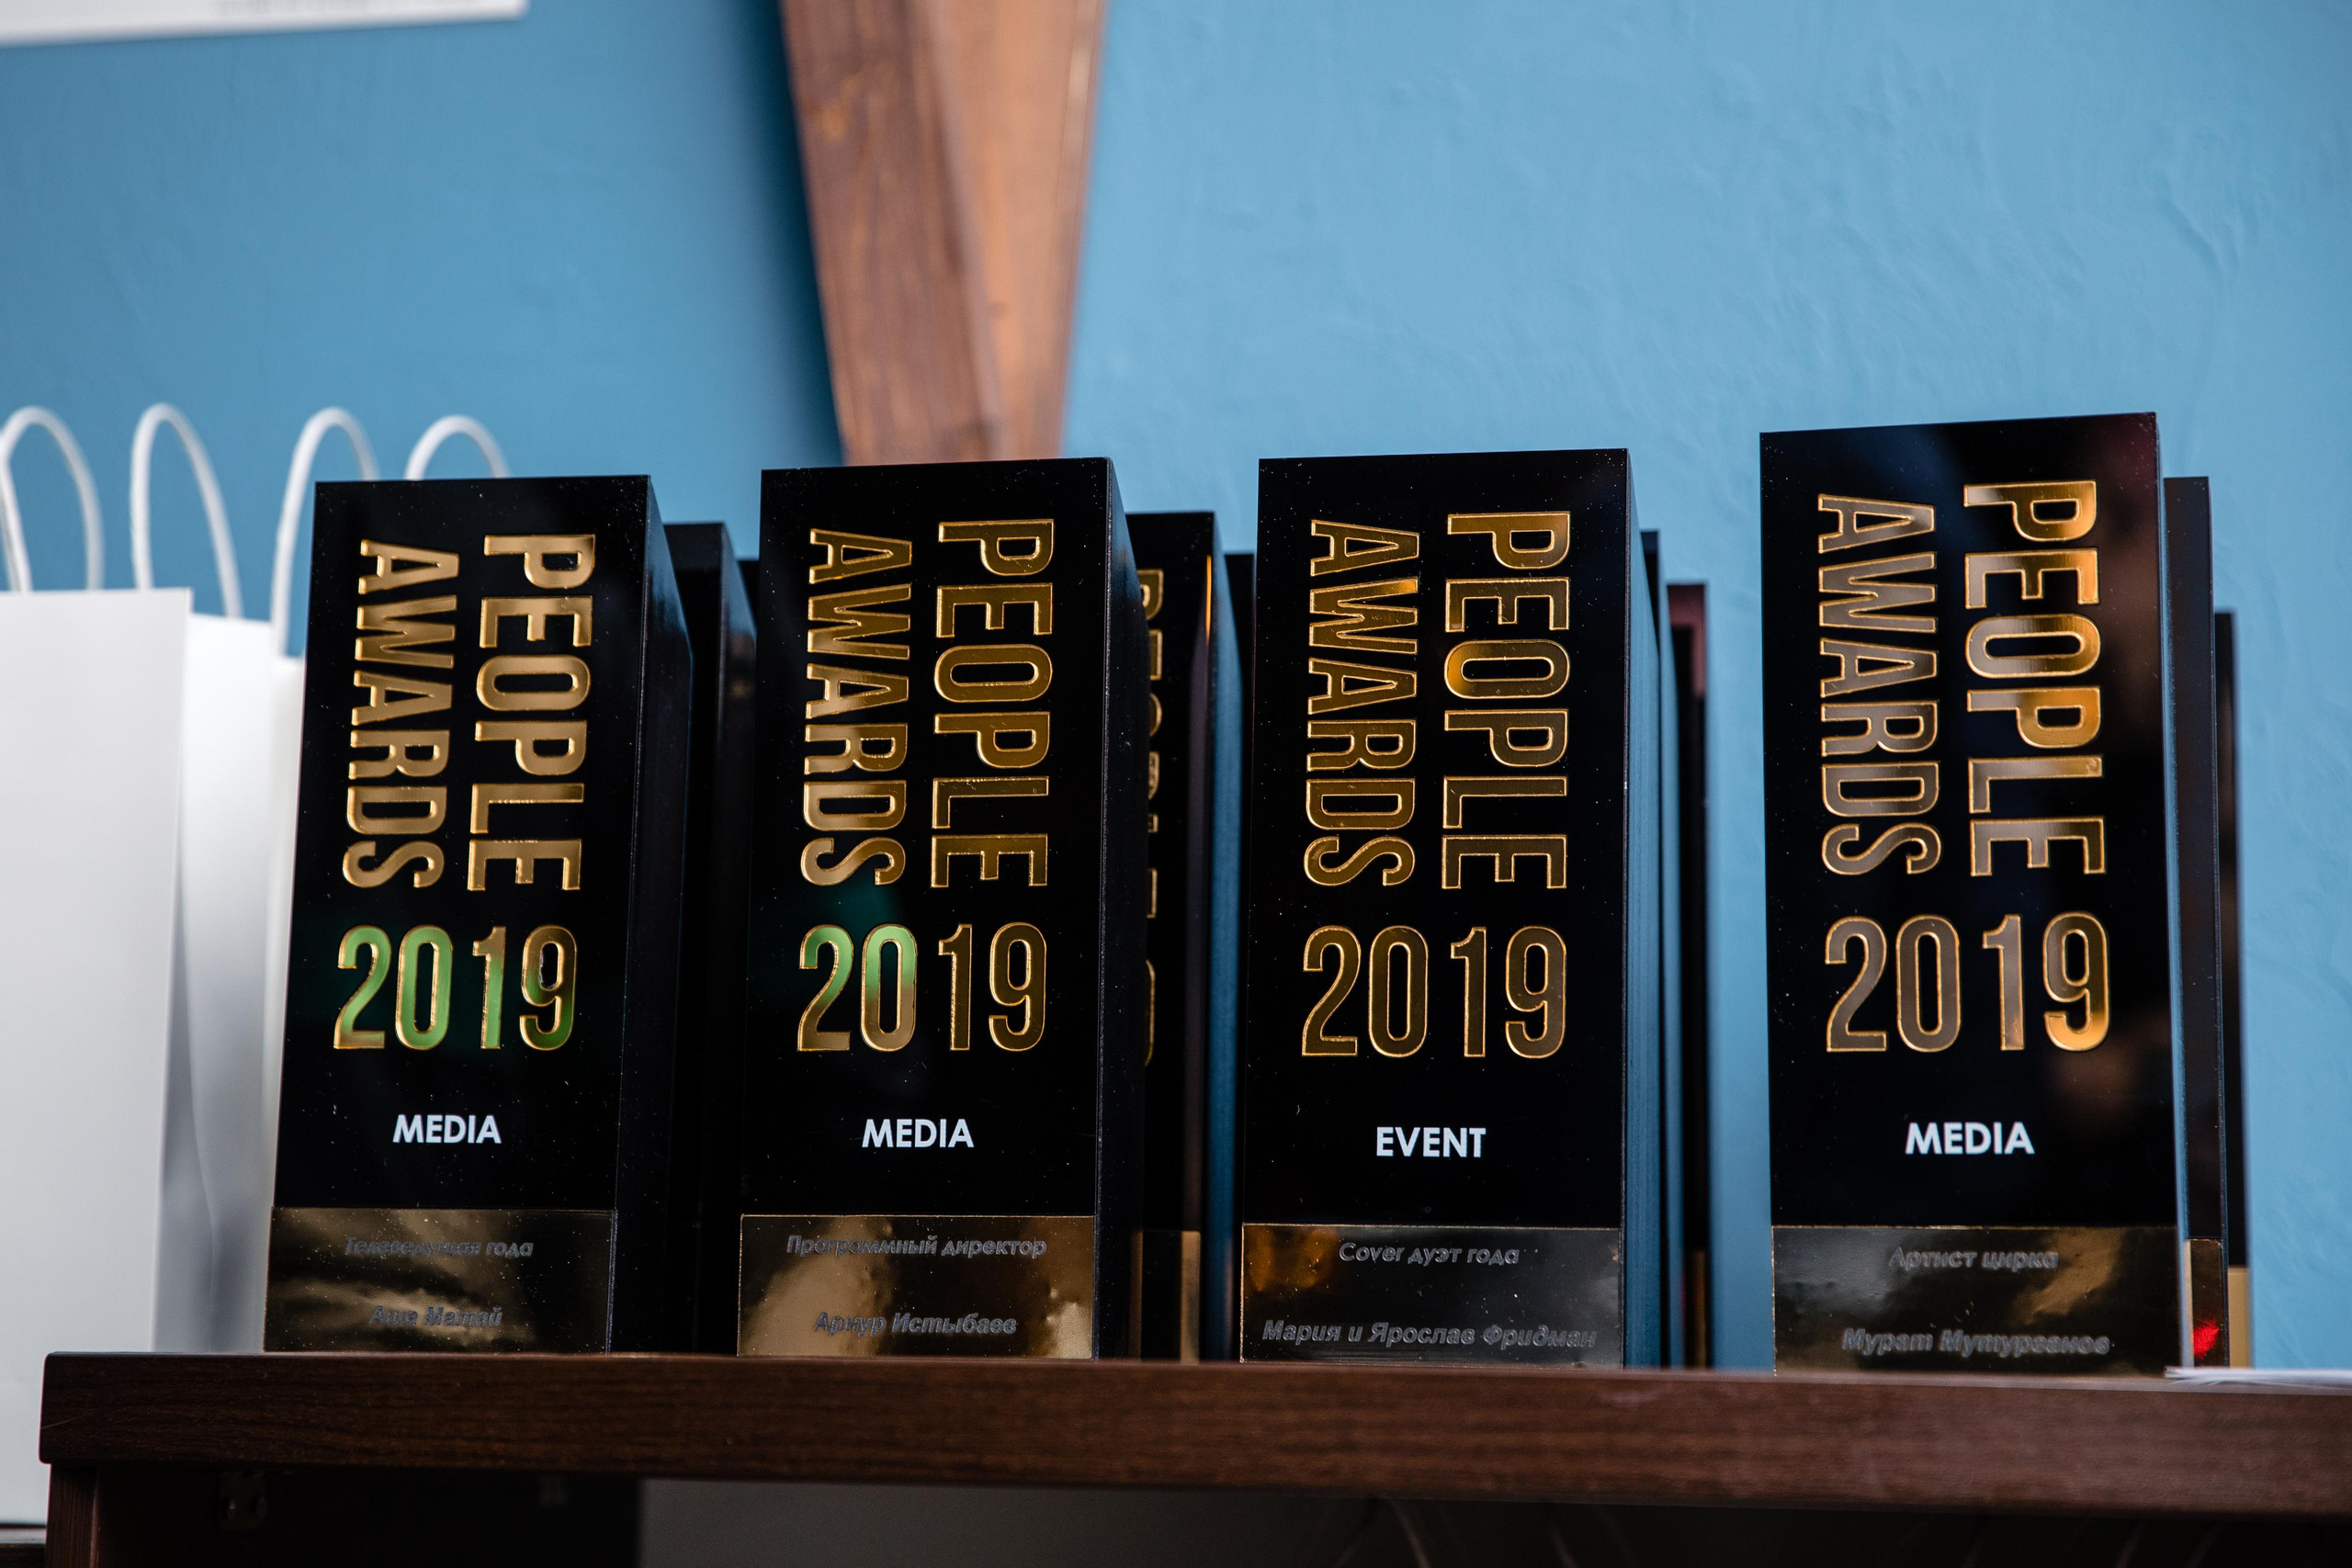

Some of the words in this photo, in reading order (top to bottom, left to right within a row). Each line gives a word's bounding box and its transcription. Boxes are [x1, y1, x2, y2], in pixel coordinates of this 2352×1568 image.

[343, 540, 459, 887] AWARDS
[468, 535, 595, 891] PEOPLE
[800, 528, 912, 886] AWARDS
[931, 519, 1054, 887] PEOPLE
[1304, 520, 1419, 886] AWARDS
[1442, 511, 1570, 889] PEOPLE
[1818, 494, 1941, 875] AWARDS
[1963, 480, 2105, 876] PEOPLE
[334, 925, 577, 1051] 2019
[797, 922, 1046, 1053] 2019
[1302, 926, 1566, 1059] 2019
[1825, 912, 2109, 1053] 2019
[393, 1114, 502, 1145] MEDIA
[862, 1119, 974, 1148] MEDIA
[1376, 1127, 1487, 1158] EVENT
[1905, 1122, 2035, 1156] MEDIA
[486, 1242, 534, 1258] года
[786, 1235, 938, 1258] Программный
[942, 1237, 1047, 1258] директор
[1339, 1242, 1405, 1263] Cover
[1408, 1247, 1463, 1266] дуэт
[1467, 1247, 1521, 1266] года
[1889, 1247, 1977, 1270] Артист
[1982, 1250, 2058, 1272] цирка
[814, 1311, 887, 1336] Арнур
[891, 1312, 1017, 1335] Истыбаев
[1261, 1319, 1341, 1345] Мария
[1348, 1326, 1363, 1343] и
[1368, 1322, 1476, 1345] Ярослав
[1482, 1324, 1598, 1350] Фридман
[1842, 1327, 1933, 1355] Мурат
